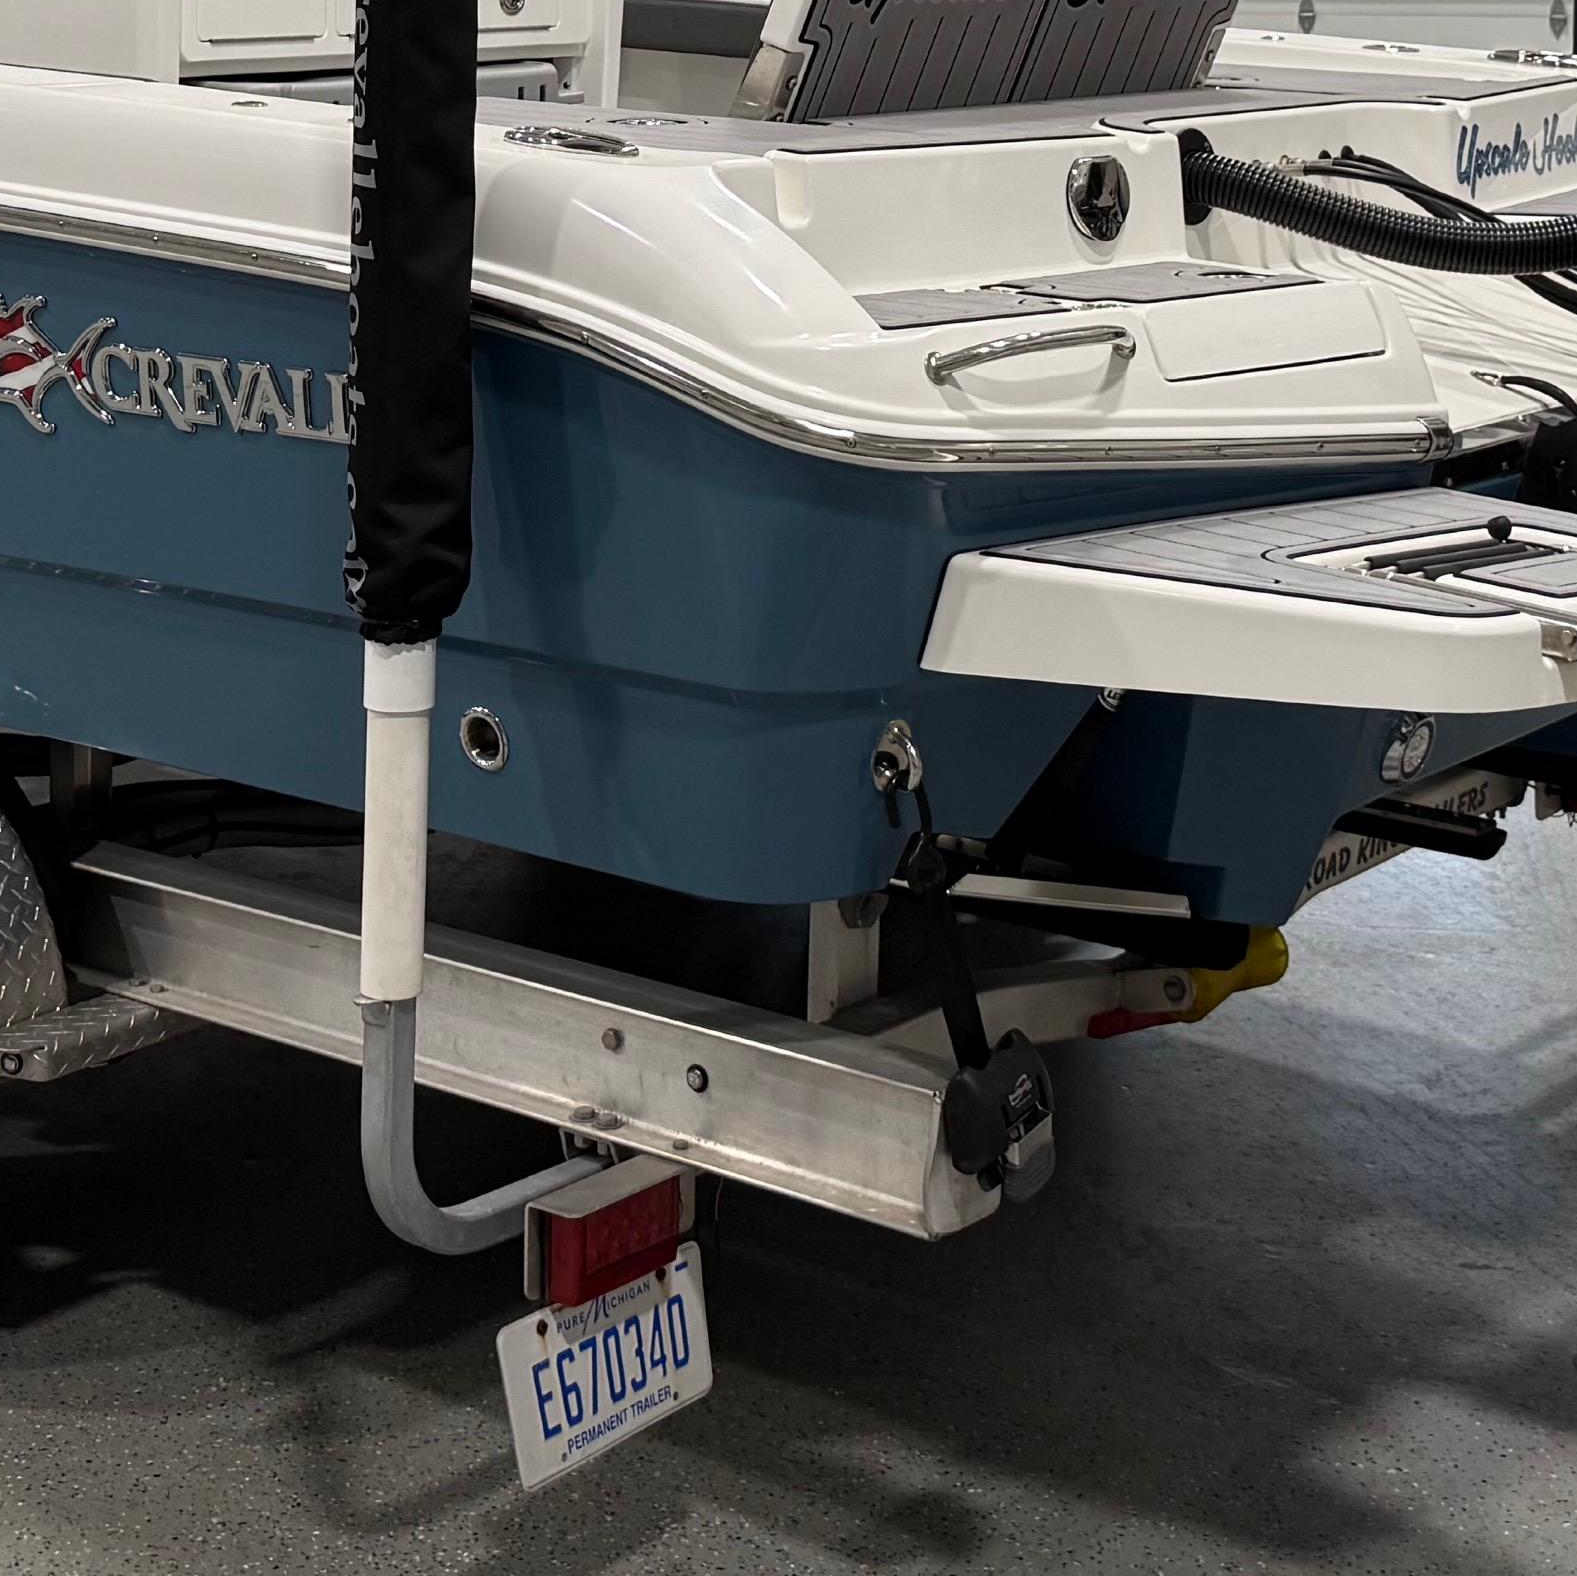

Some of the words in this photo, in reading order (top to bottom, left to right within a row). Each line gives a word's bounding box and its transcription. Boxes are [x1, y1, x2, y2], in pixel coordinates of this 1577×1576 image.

[1456, 122, 1531, 200] Upscale
[1306, 845, 1351, 890] OAD
[1356, 833, 1398, 865] KIN
[556, 1311, 586, 1334] PURE
[581, 1281, 651, 1336] MICHIGAN
[532, 1293, 690, 1441] E670340
[567, 1408, 629, 1455] PERMANENT
[630, 1384, 672, 1418] TRAILER
